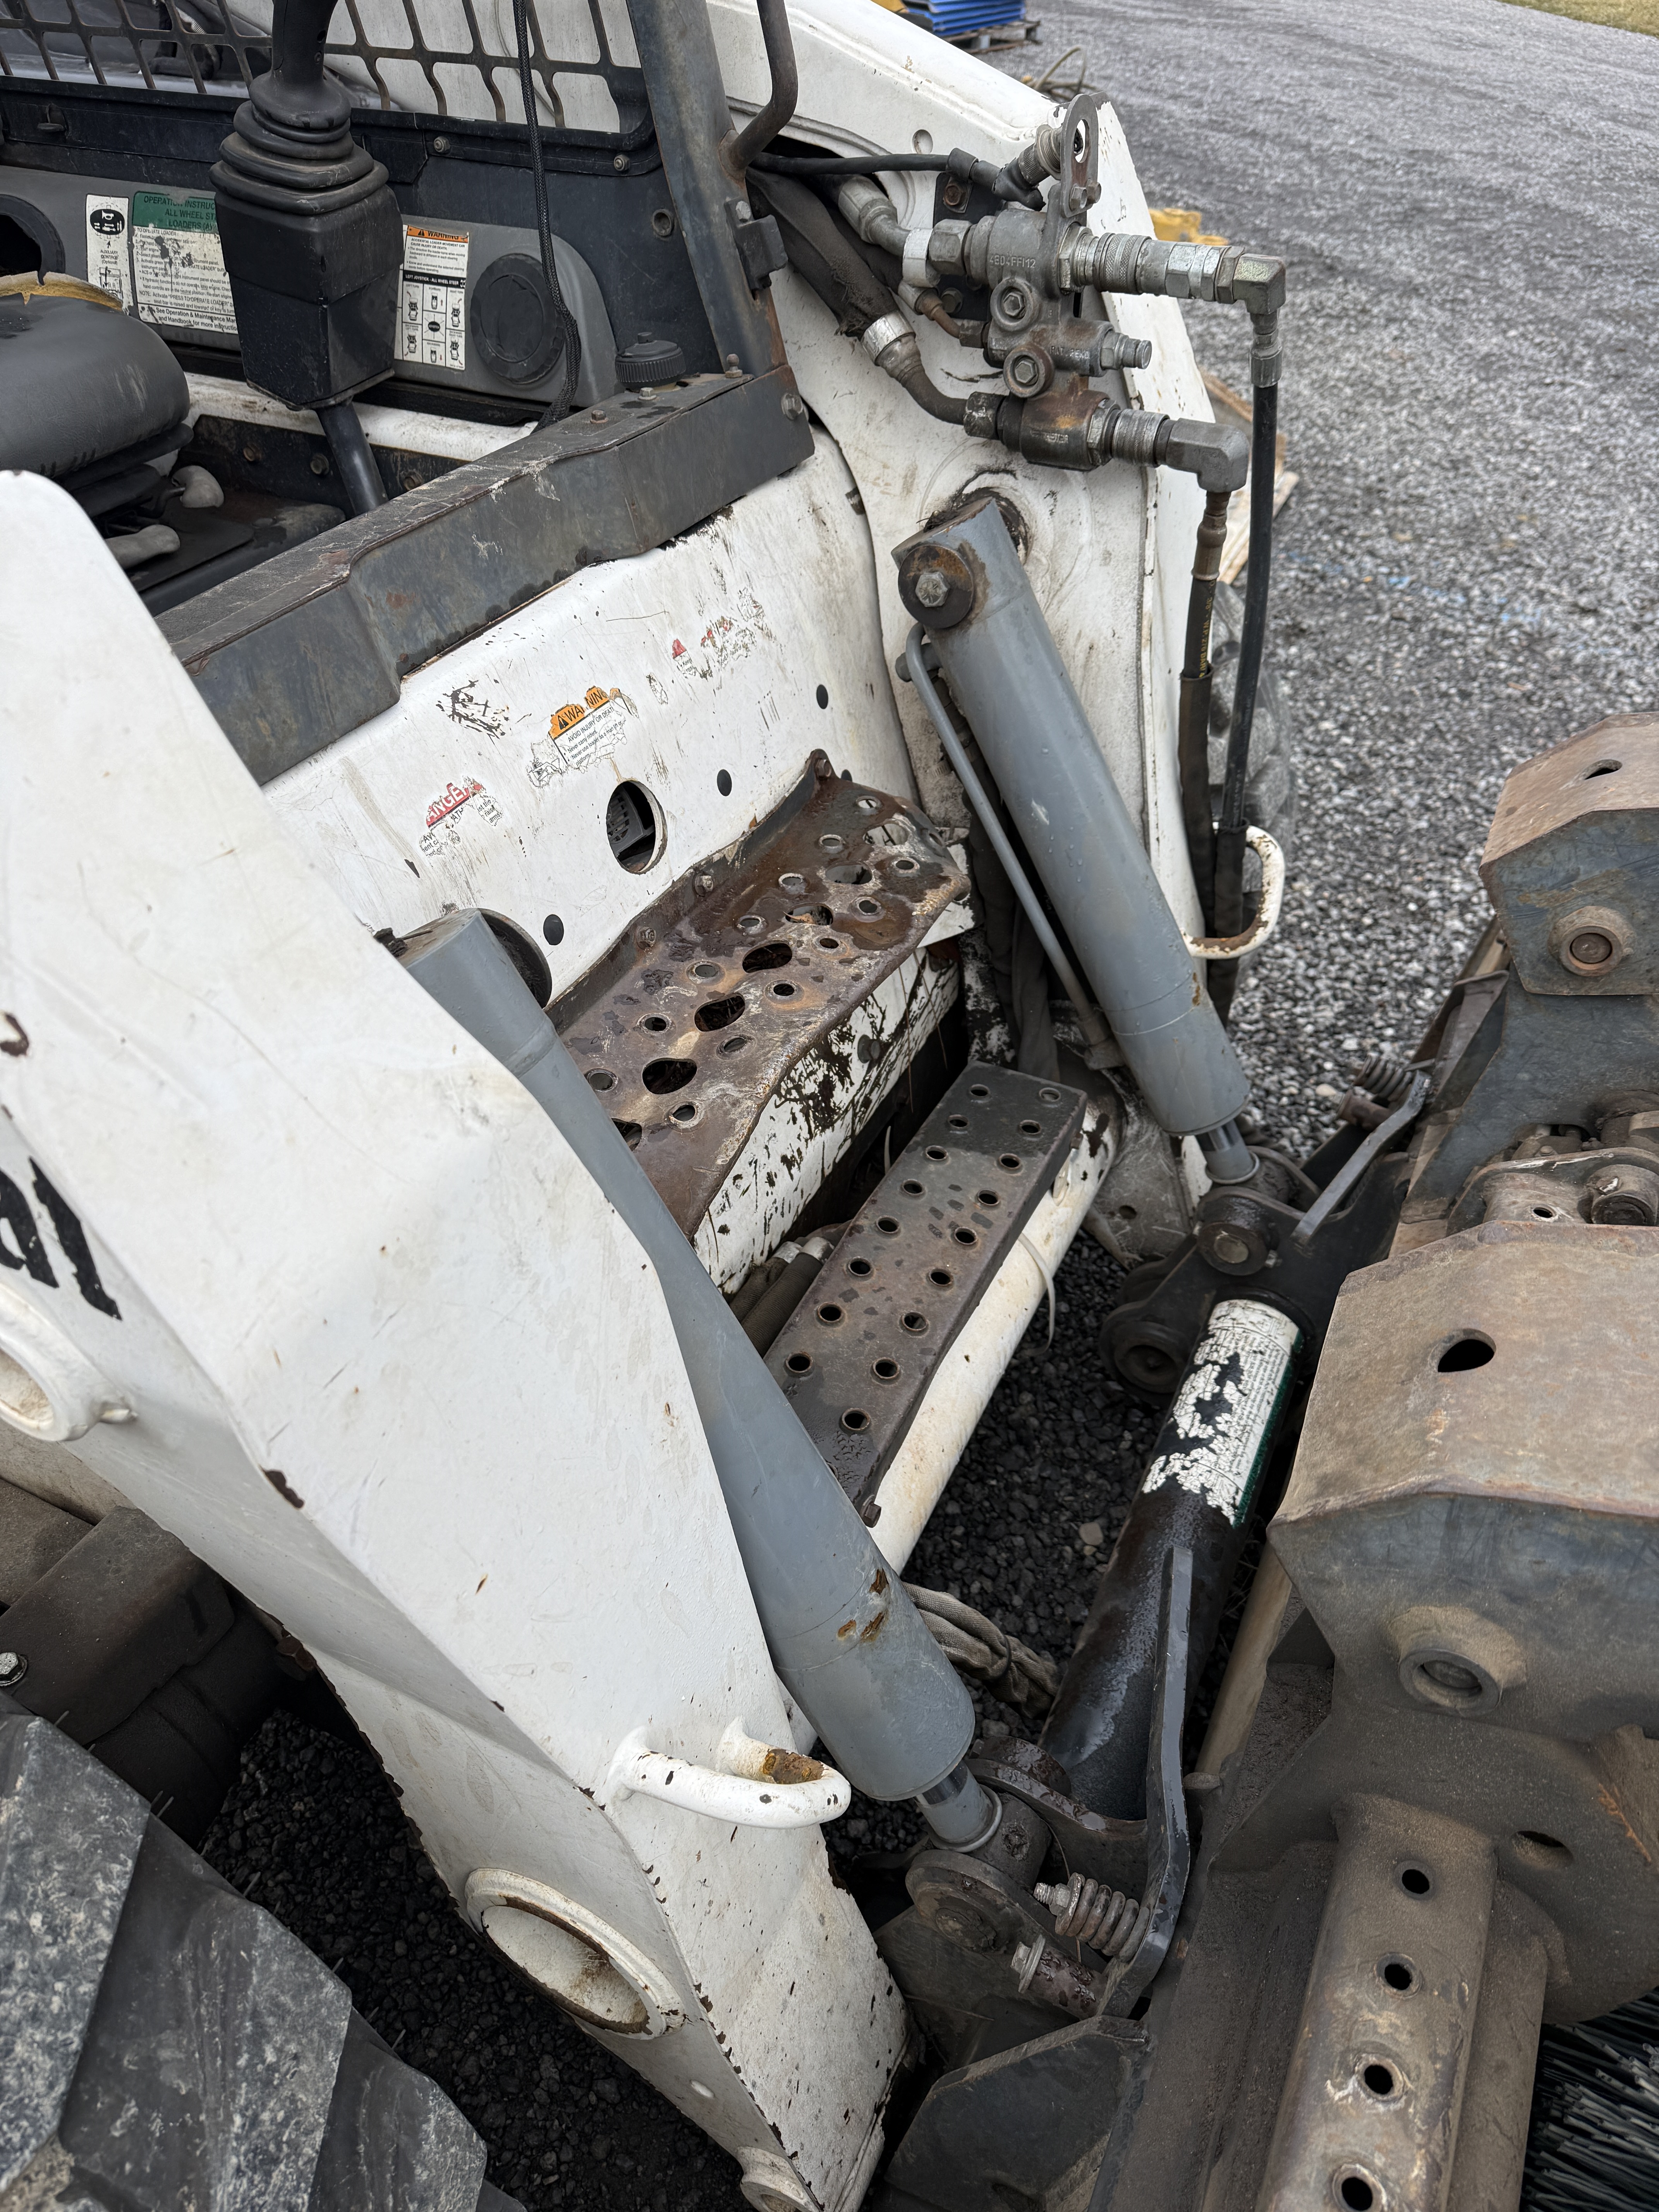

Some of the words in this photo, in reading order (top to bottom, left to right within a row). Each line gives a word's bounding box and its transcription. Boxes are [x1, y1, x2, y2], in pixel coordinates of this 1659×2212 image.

[144, 196, 182, 206] OPERATI
[180, 210, 204, 219] WHEEL
[168, 220, 201, 229] LOADERS
[166, 309, 189, 317] Operation
[194, 313, 225, 322] Maintenance
[168, 316, 191, 325] Handbook
[568, 730, 581, 743] AVOID
[581, 720, 595, 734] INJURY
[568, 743, 579, 753] Never
[571, 750, 582, 760] Never
